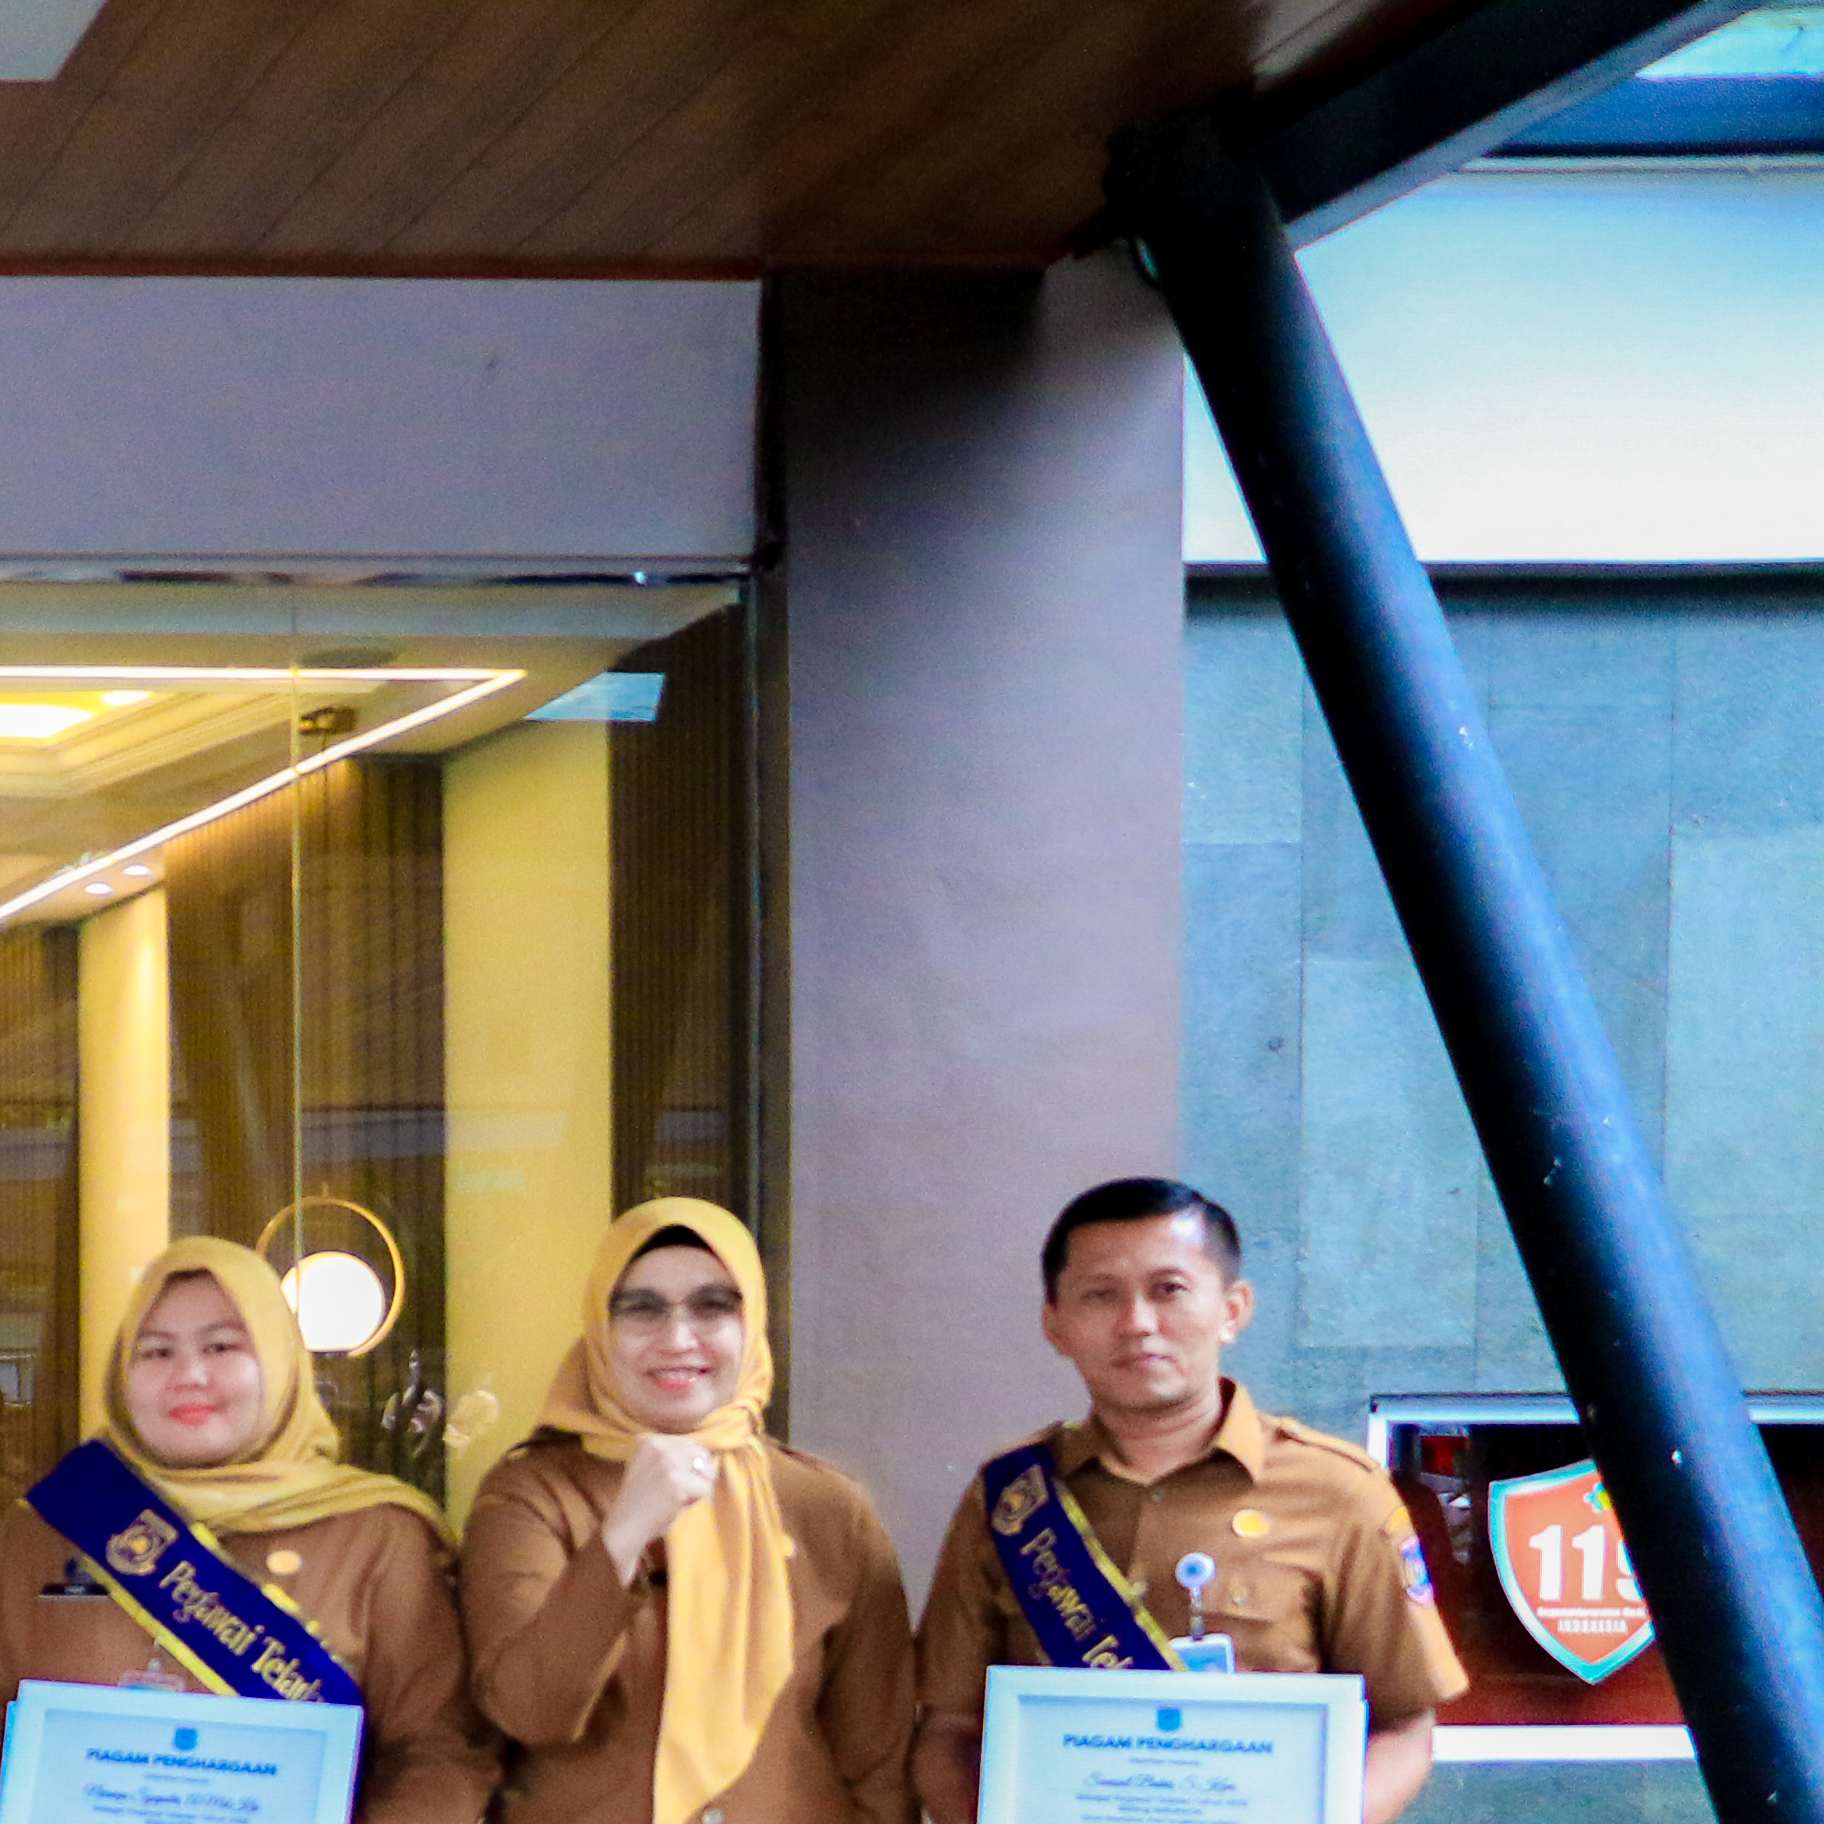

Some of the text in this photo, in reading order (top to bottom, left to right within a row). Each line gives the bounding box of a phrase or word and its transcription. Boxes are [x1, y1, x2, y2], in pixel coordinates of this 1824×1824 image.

[158, 1560, 265, 1656] Pegawai
[1063, 1733, 1274, 1754] PIAGAM PENGHARGAAN
[86, 1748, 149, 1763] PIAGAM
